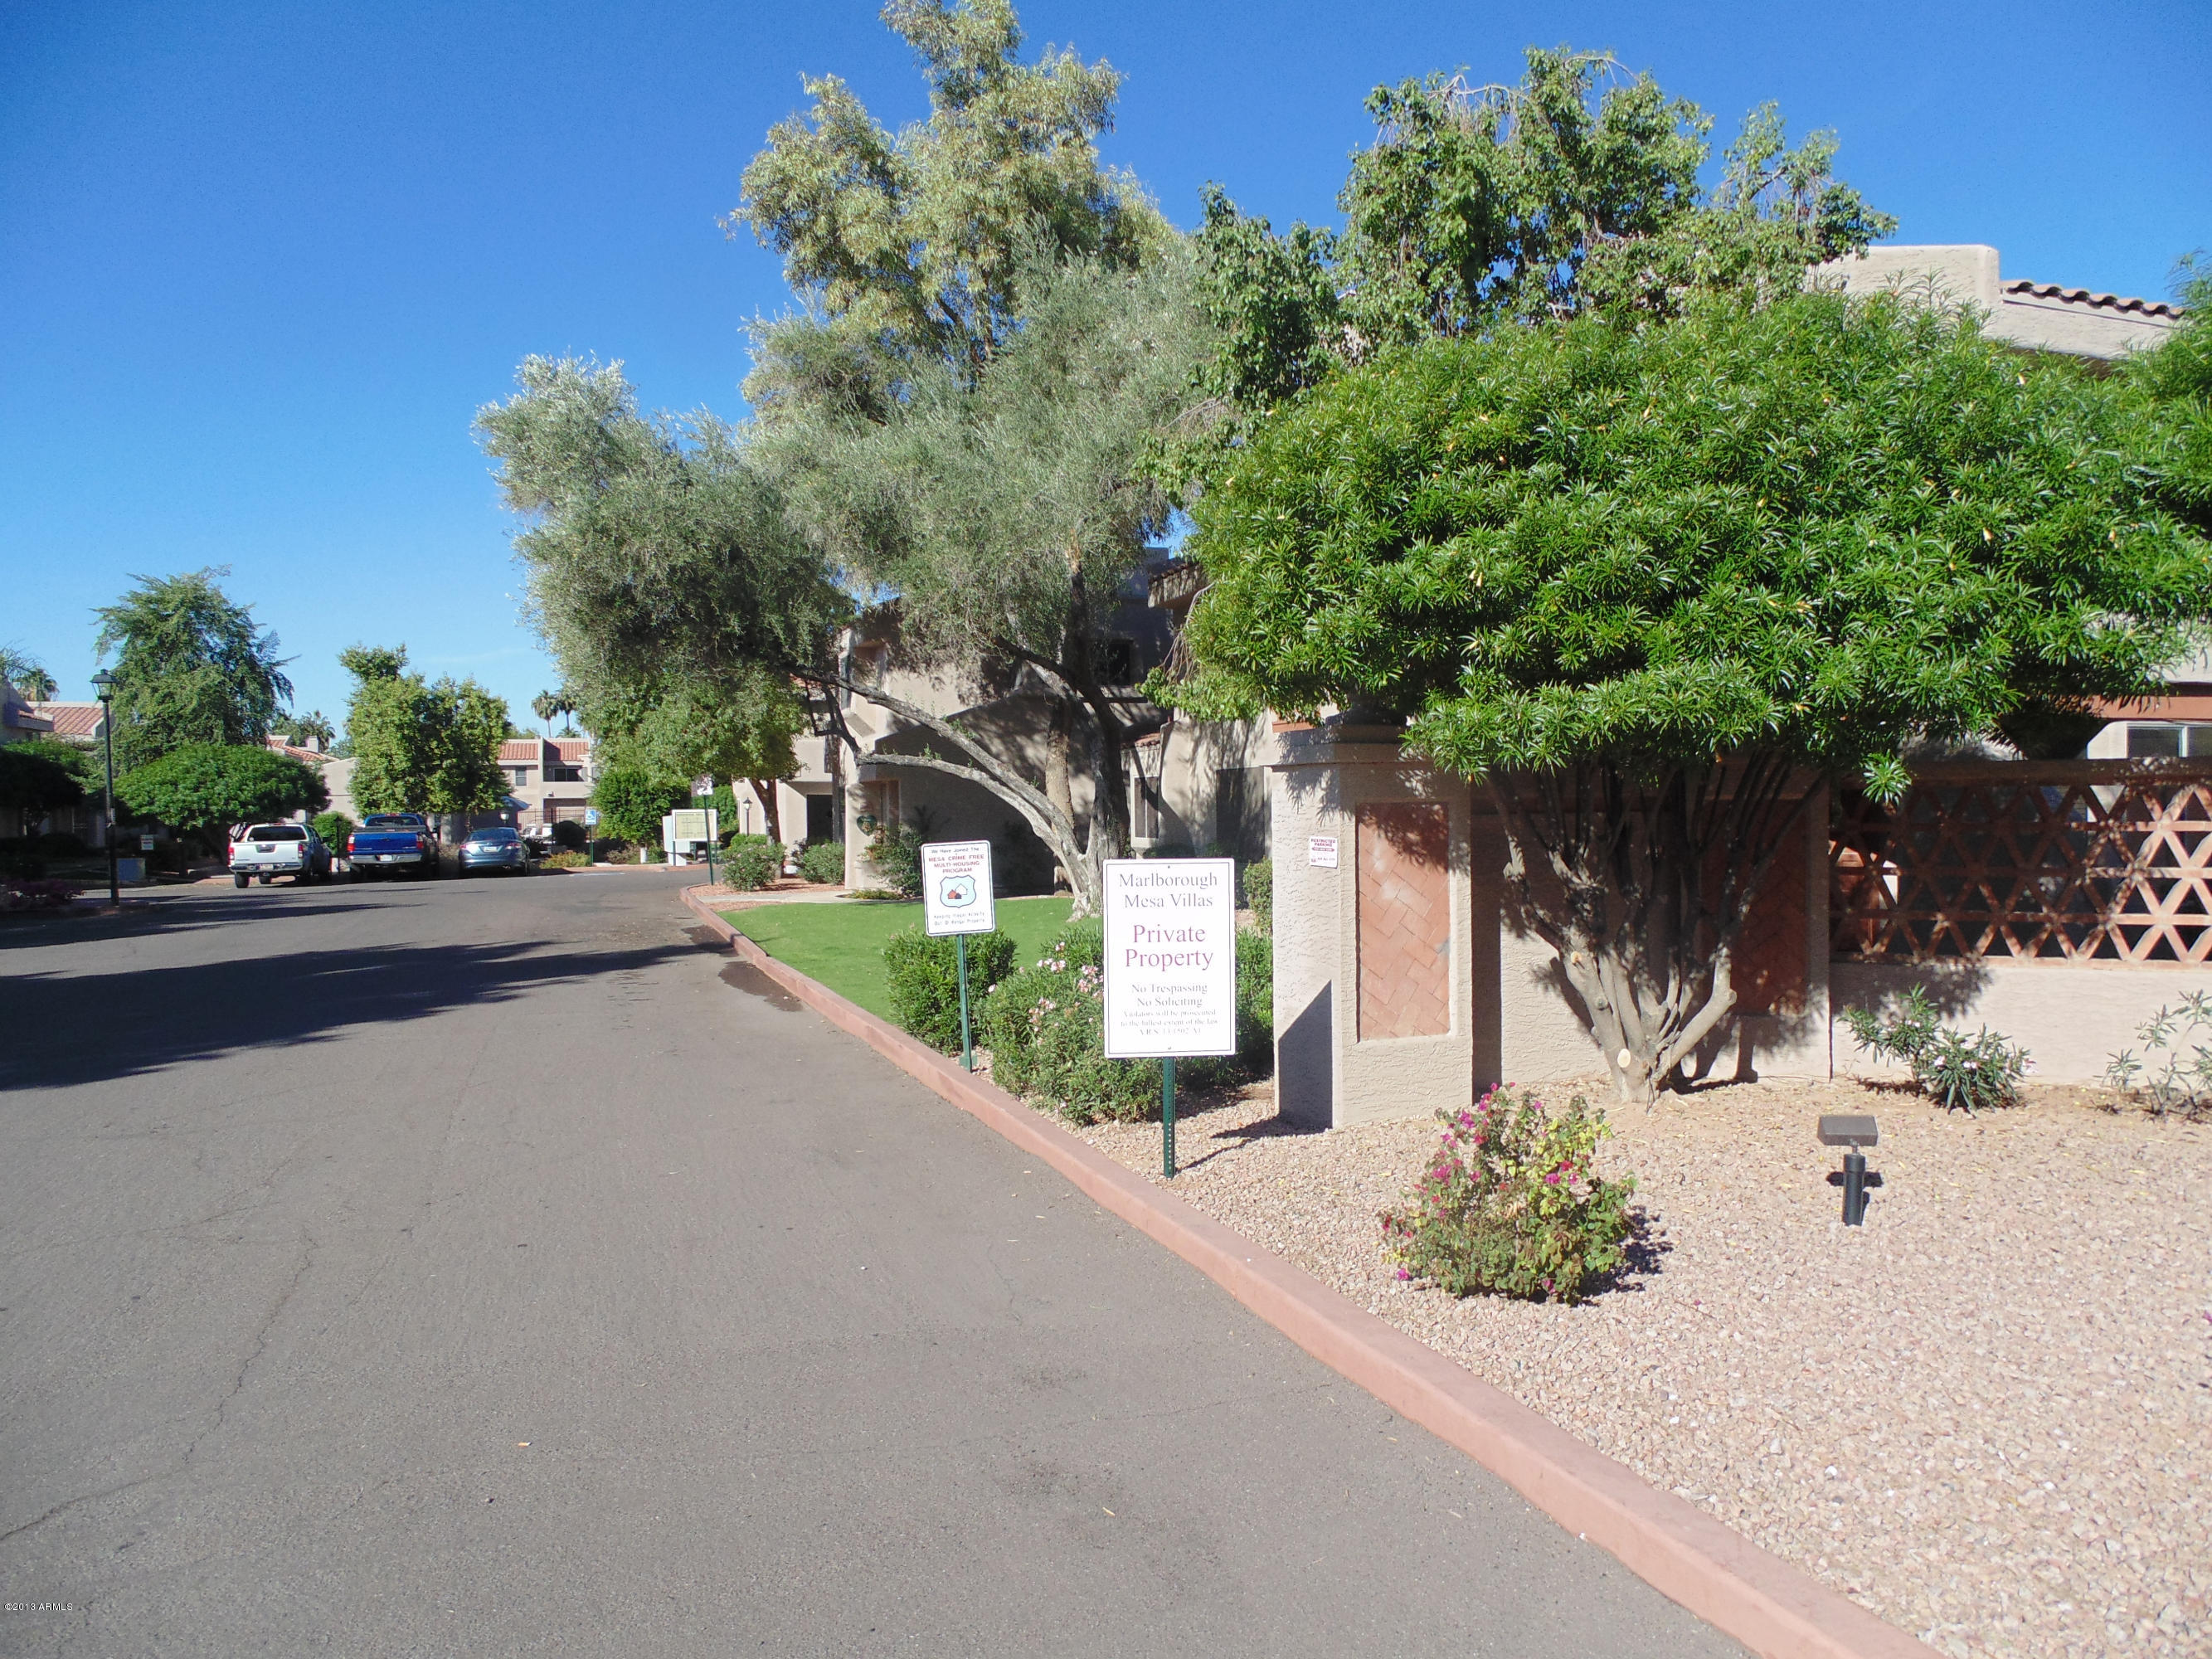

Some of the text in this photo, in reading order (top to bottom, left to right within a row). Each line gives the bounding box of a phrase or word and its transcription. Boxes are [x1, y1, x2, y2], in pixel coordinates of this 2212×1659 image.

[1120, 872, 1218, 890] Marlborough
[1125, 893, 1213, 907] Mesa Villas
[1133, 924, 1206, 943] Private
[1125, 949, 1213, 971] Property
[1132, 983, 1208, 995] No Trespassing
[1137, 997, 1203, 1008] No Soliciting
